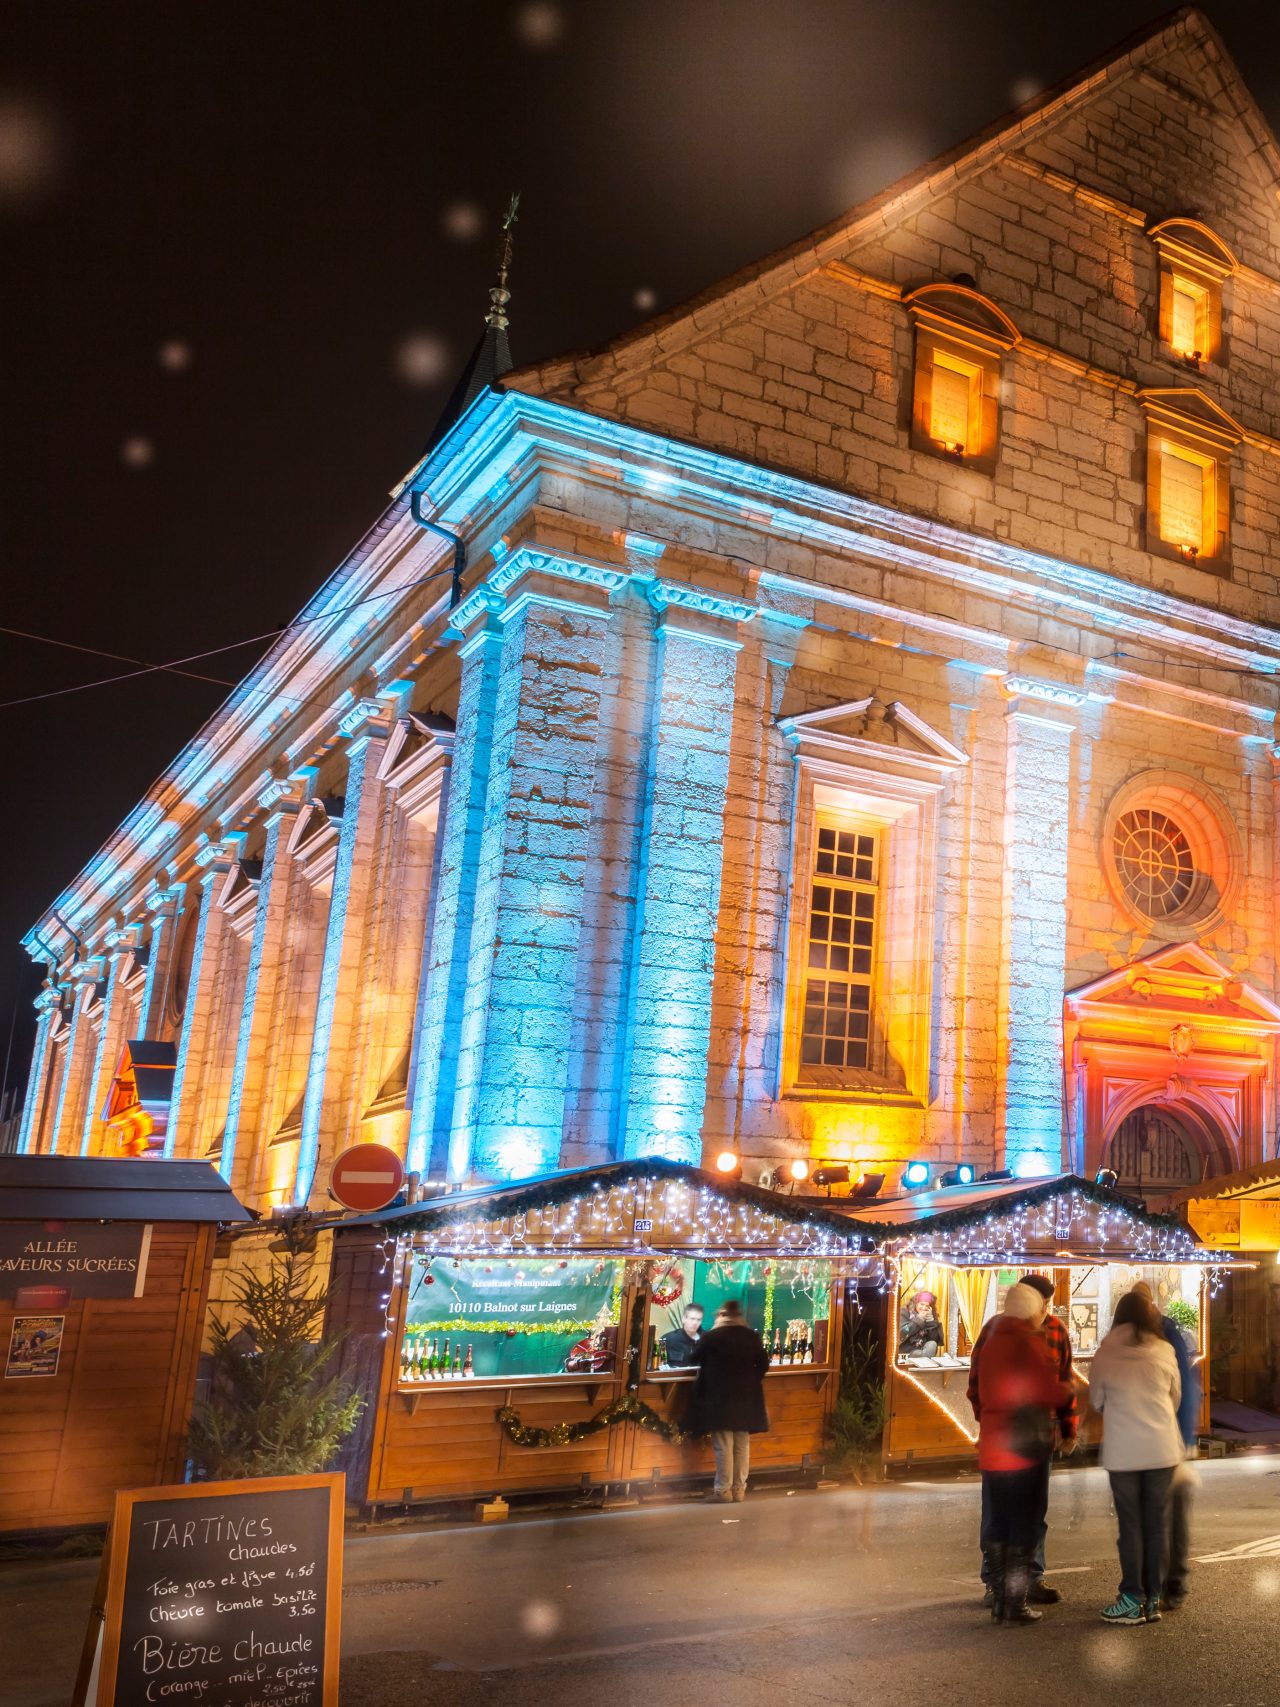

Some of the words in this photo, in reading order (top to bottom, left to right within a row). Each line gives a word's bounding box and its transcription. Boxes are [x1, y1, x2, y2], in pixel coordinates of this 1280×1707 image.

[24, 1238, 78, 1253] ALLÉE
[66, 1256, 136, 1273] SUCRÉES
[449, 1302, 481, 1314] 10110
[484, 1302, 518, 1313] Balnot
[520, 1304, 536, 1312] sur
[539, 1301, 577, 1314] Laignes
[185, 1579, 215, 1598] gras
[221, 1573, 237, 1586] et
[216, 1596, 264, 1613] tomate
